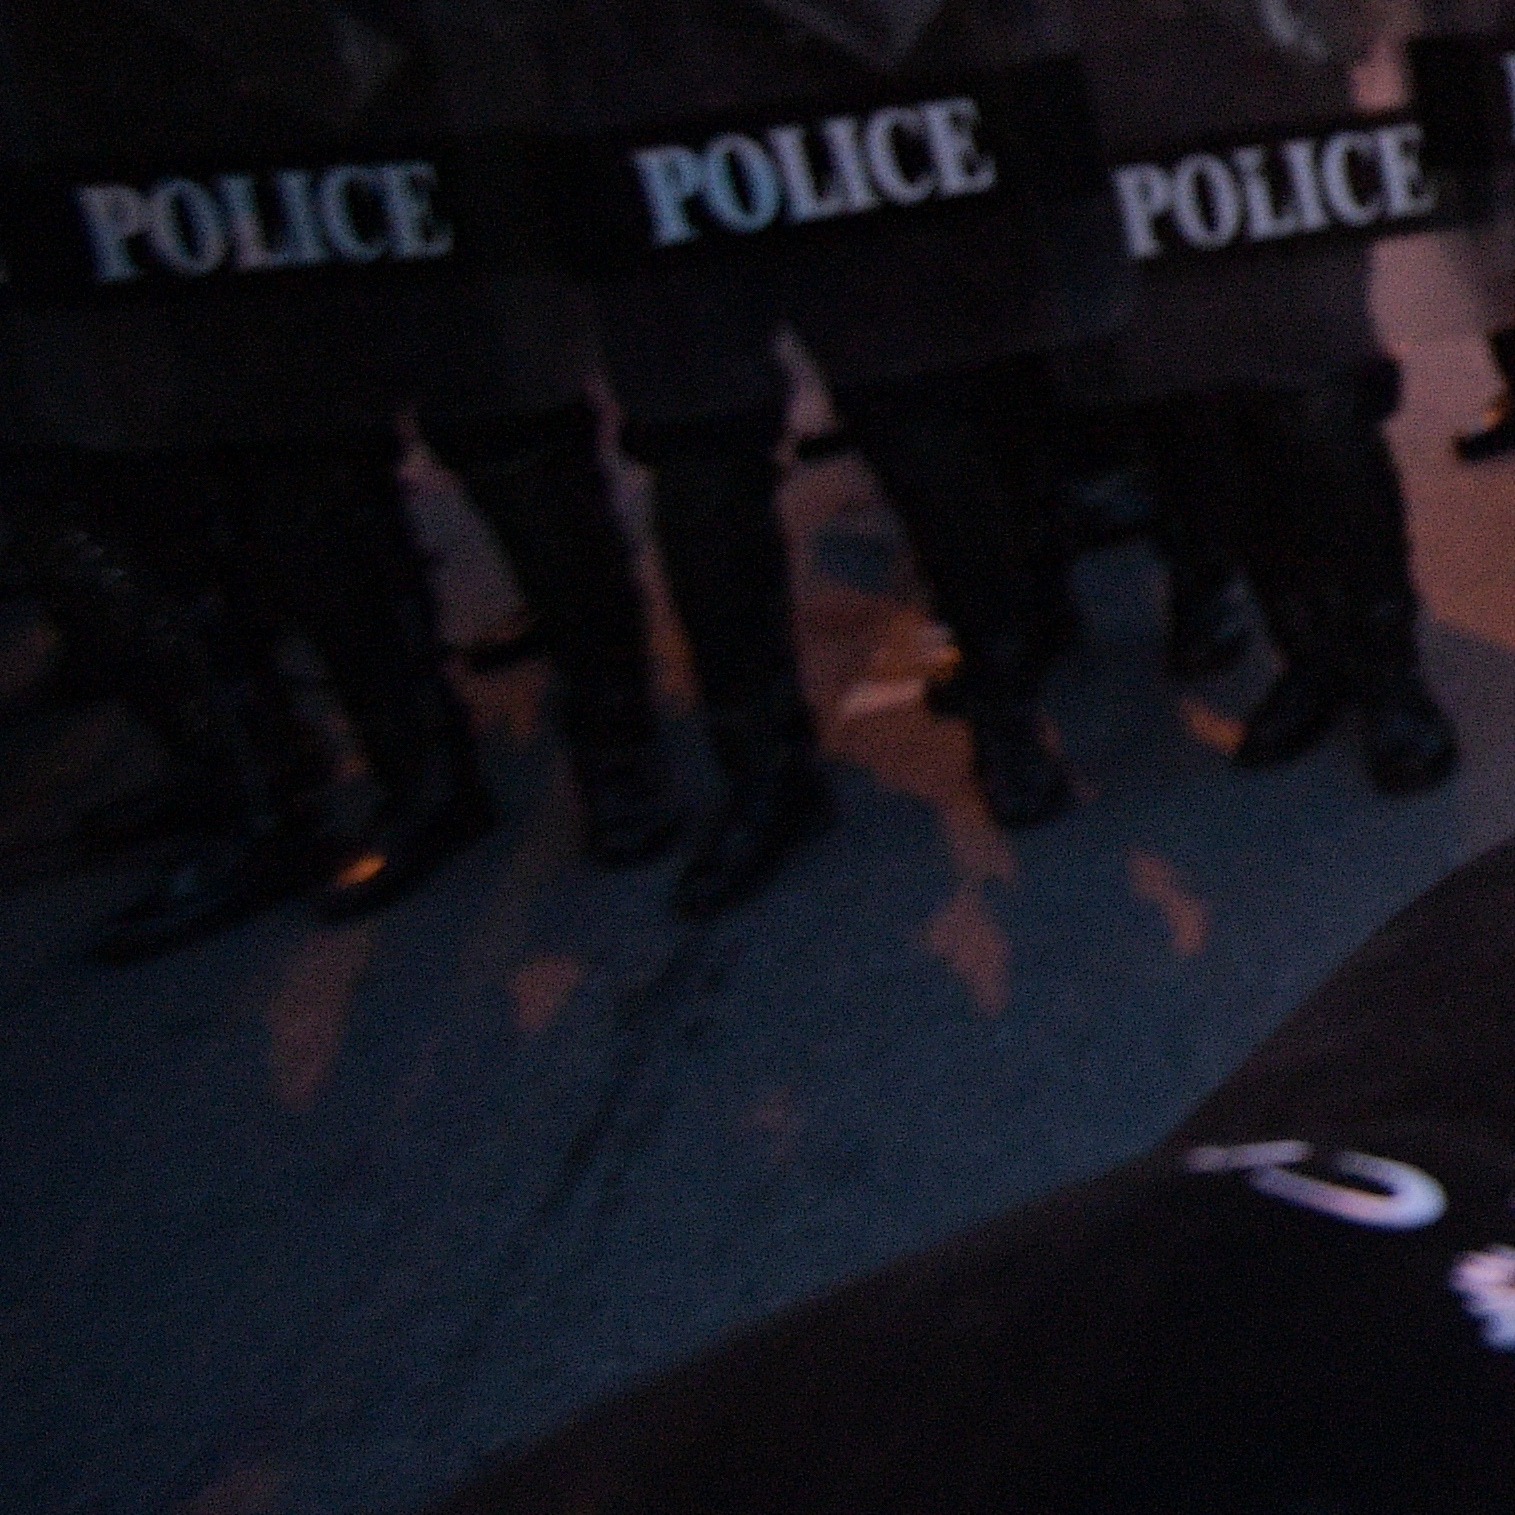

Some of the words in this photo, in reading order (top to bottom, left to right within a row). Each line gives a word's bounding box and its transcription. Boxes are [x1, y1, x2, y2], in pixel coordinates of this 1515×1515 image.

[76, 160, 455, 283] POLICE
[634, 95, 997, 245] POLICE
[1111, 122, 1440, 260] POLICE
